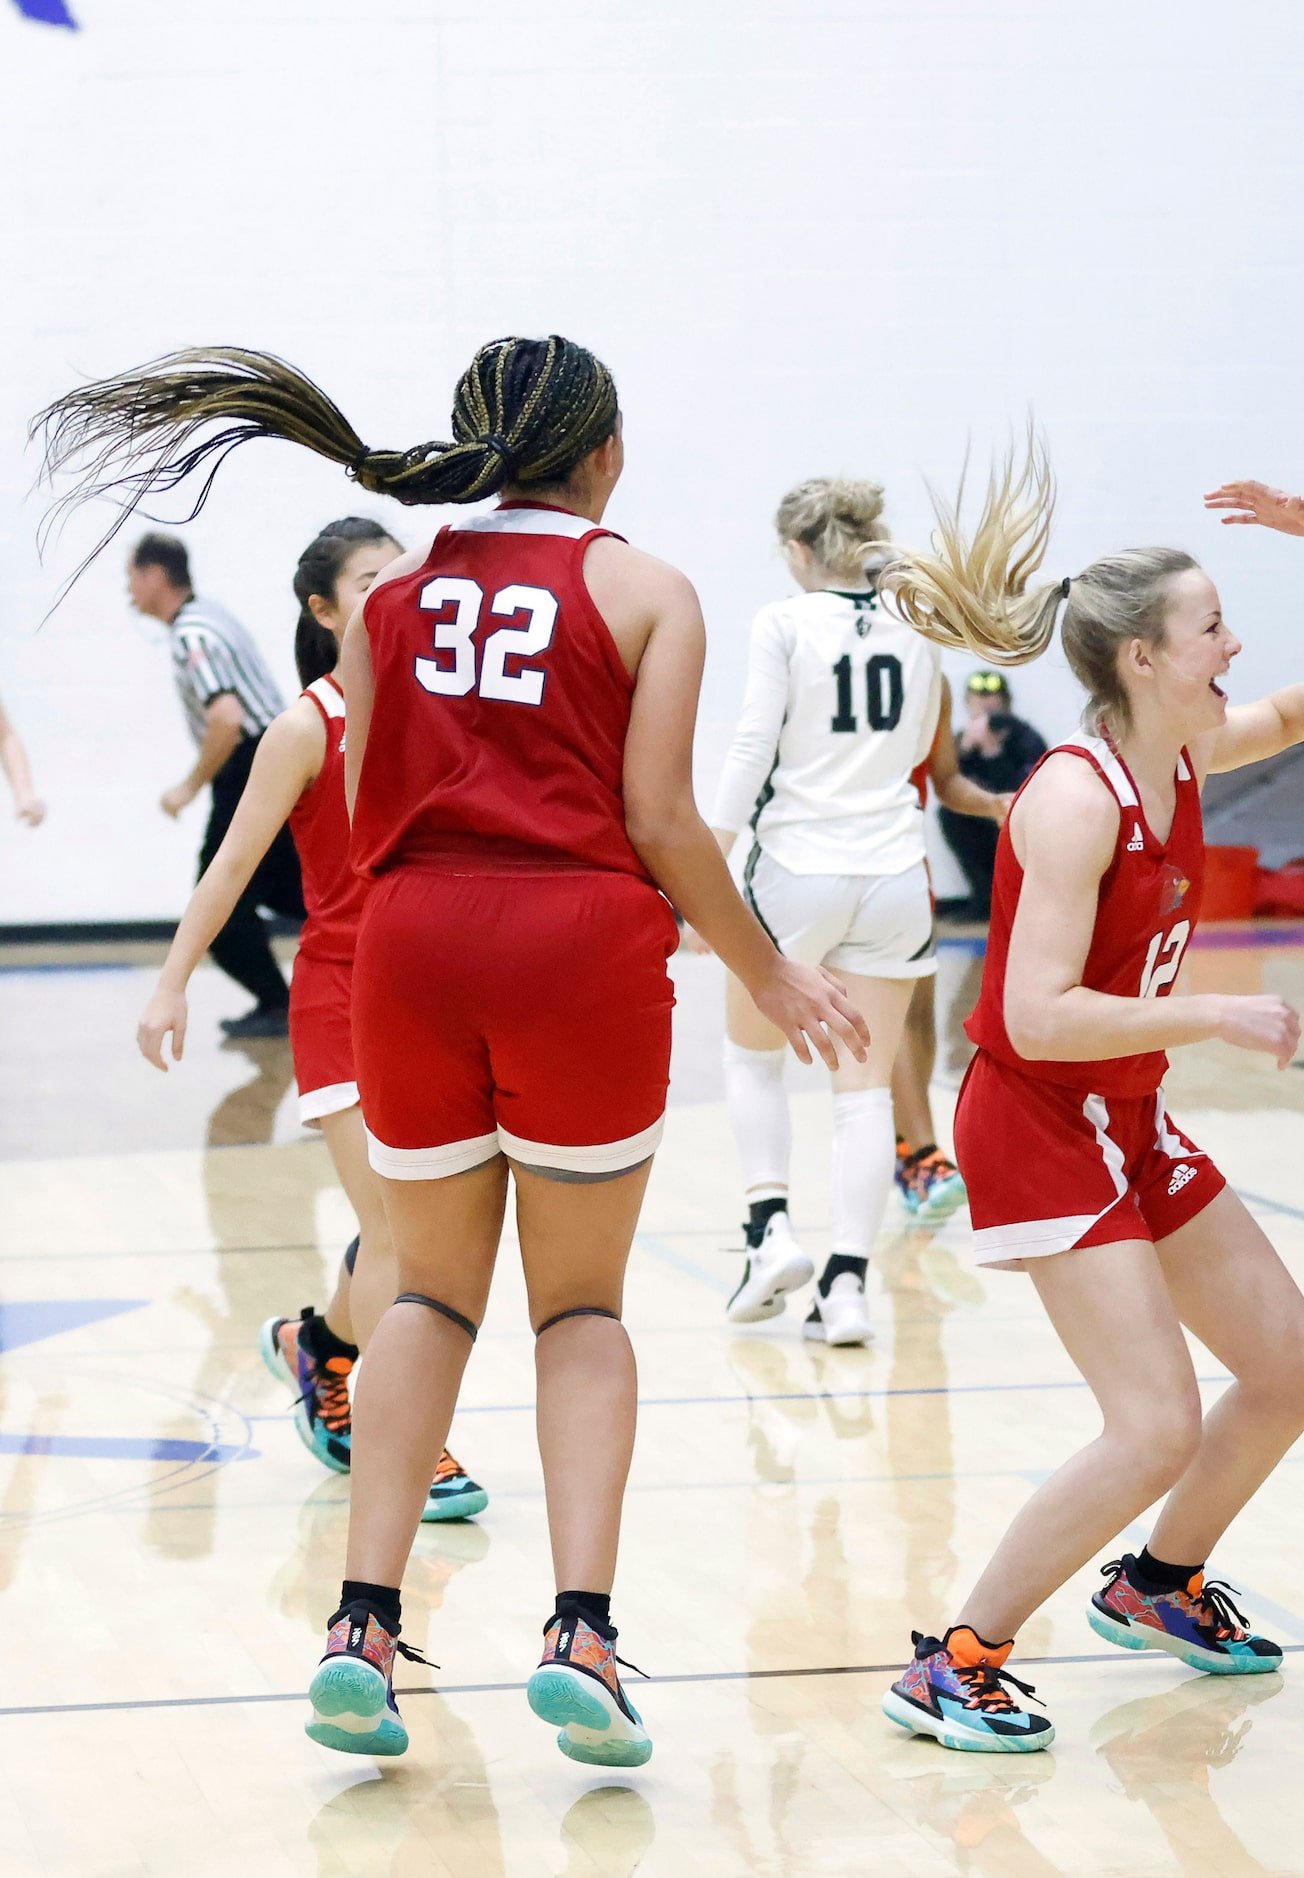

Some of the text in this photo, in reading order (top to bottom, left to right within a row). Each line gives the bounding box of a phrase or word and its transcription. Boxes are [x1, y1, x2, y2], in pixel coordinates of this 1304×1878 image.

[414, 575, 561, 707] 32
[830, 652, 905, 734] 10
[1138, 918, 1191, 999] 12
[1168, 1167, 1198, 1196] adidas
